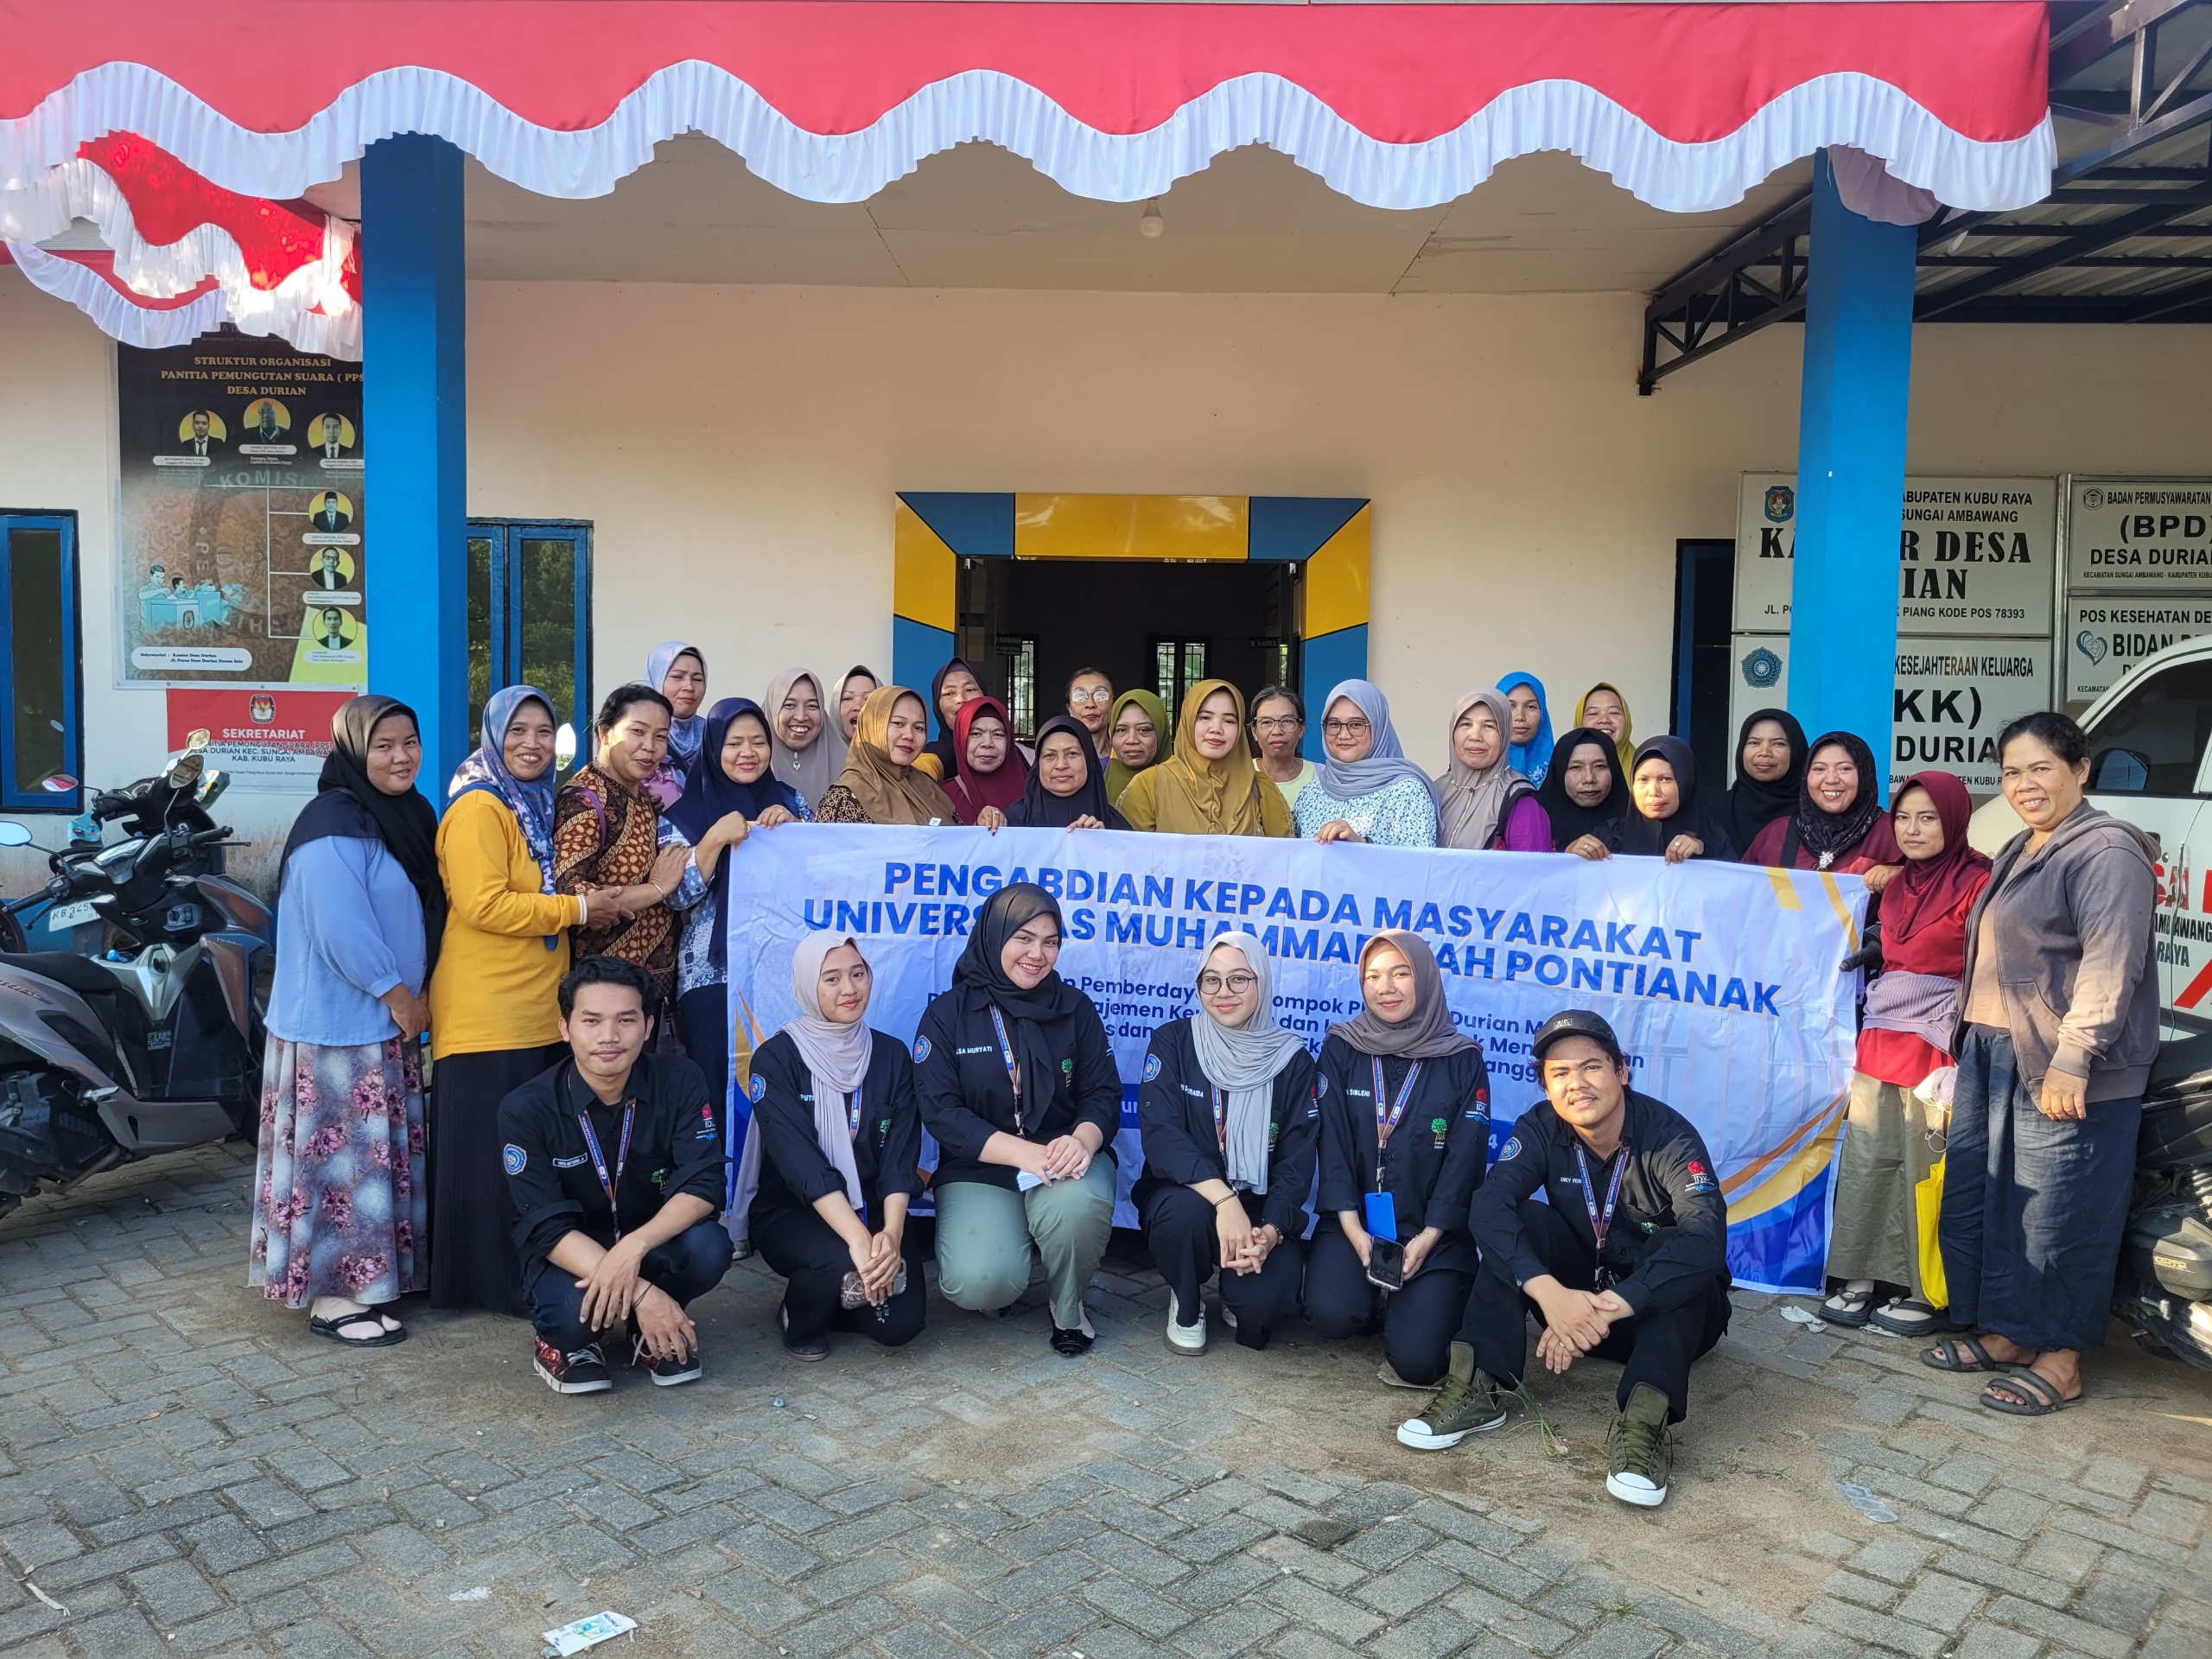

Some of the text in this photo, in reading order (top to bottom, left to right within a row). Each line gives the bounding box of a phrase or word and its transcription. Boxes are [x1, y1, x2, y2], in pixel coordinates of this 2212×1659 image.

[194, 356, 332, 367] STRUKTUR ORGANISASI
[161, 370, 208, 379] PANITIA
[211, 371, 292, 381] PEMUNGUTAN
[295, 372, 334, 382] SUARA
[227, 385, 306, 396] DESA DURIAN
[1964, 492, 1998, 505] KUBU
[2003, 493, 2033, 505] RAYA
[2107, 492, 2211, 505] BADAN PERMUSYAWARATAN
[1948, 510, 2018, 523] AMBAWANG
[1935, 531, 2031, 563] DESA
[2090, 549, 2212, 565] DESA DURIA
[1902, 568, 1968, 600] IAN
[1764, 604, 1779, 615] JL.
[1903, 607, 2025, 620] PIANG KODE POS 78393
[2079, 610, 2212, 624] POS KESEHATAN DE
[1894, 654, 2034, 677] KESEJAHTERAAN KELUARGA
[1894, 686, 1982, 730] KK)
[222, 728, 306, 740] SEKRETARIAT
[227, 741, 283, 749] PEMUNGUTAN
[1895, 735, 1997, 763] DURIA
[1974, 775, 1995, 786] KUBU
[1184, 880, 1363, 926] KEPADA
[1373, 899, 1702, 966] MASYARAKAT
[804, 898, 1096, 941] UNIVERS
[1503, 951, 1783, 1019] PONTIANAK
[2157, 940, 2190, 968] RAYA
[1081, 976, 1198, 1005] Pemberday
[1096, 997, 1164, 1020] ajemen
[1272, 995, 1344, 1015] ompok
[1279, 1014, 1319, 1033] dan
[967, 1046, 993, 1054] MURYATI
